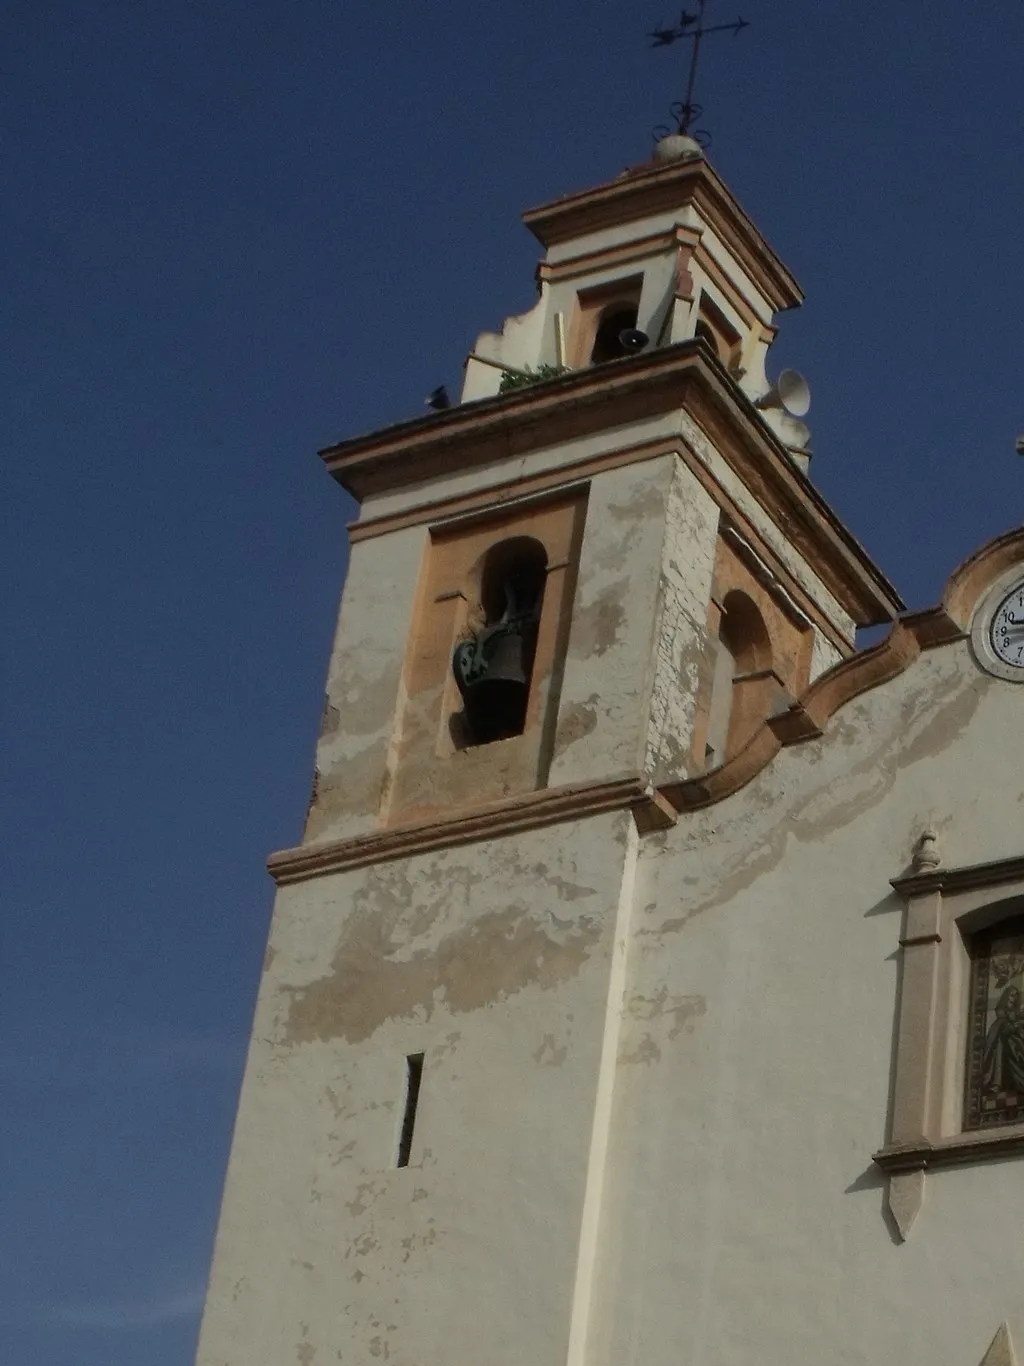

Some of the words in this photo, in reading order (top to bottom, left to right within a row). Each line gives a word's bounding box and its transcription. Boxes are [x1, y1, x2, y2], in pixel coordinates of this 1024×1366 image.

[1003, 611, 1015, 623] 10
[1000, 626, 1007, 636] 9
[1004, 638, 1010, 648] 8
[1017, 646, 1023, 658] 7
